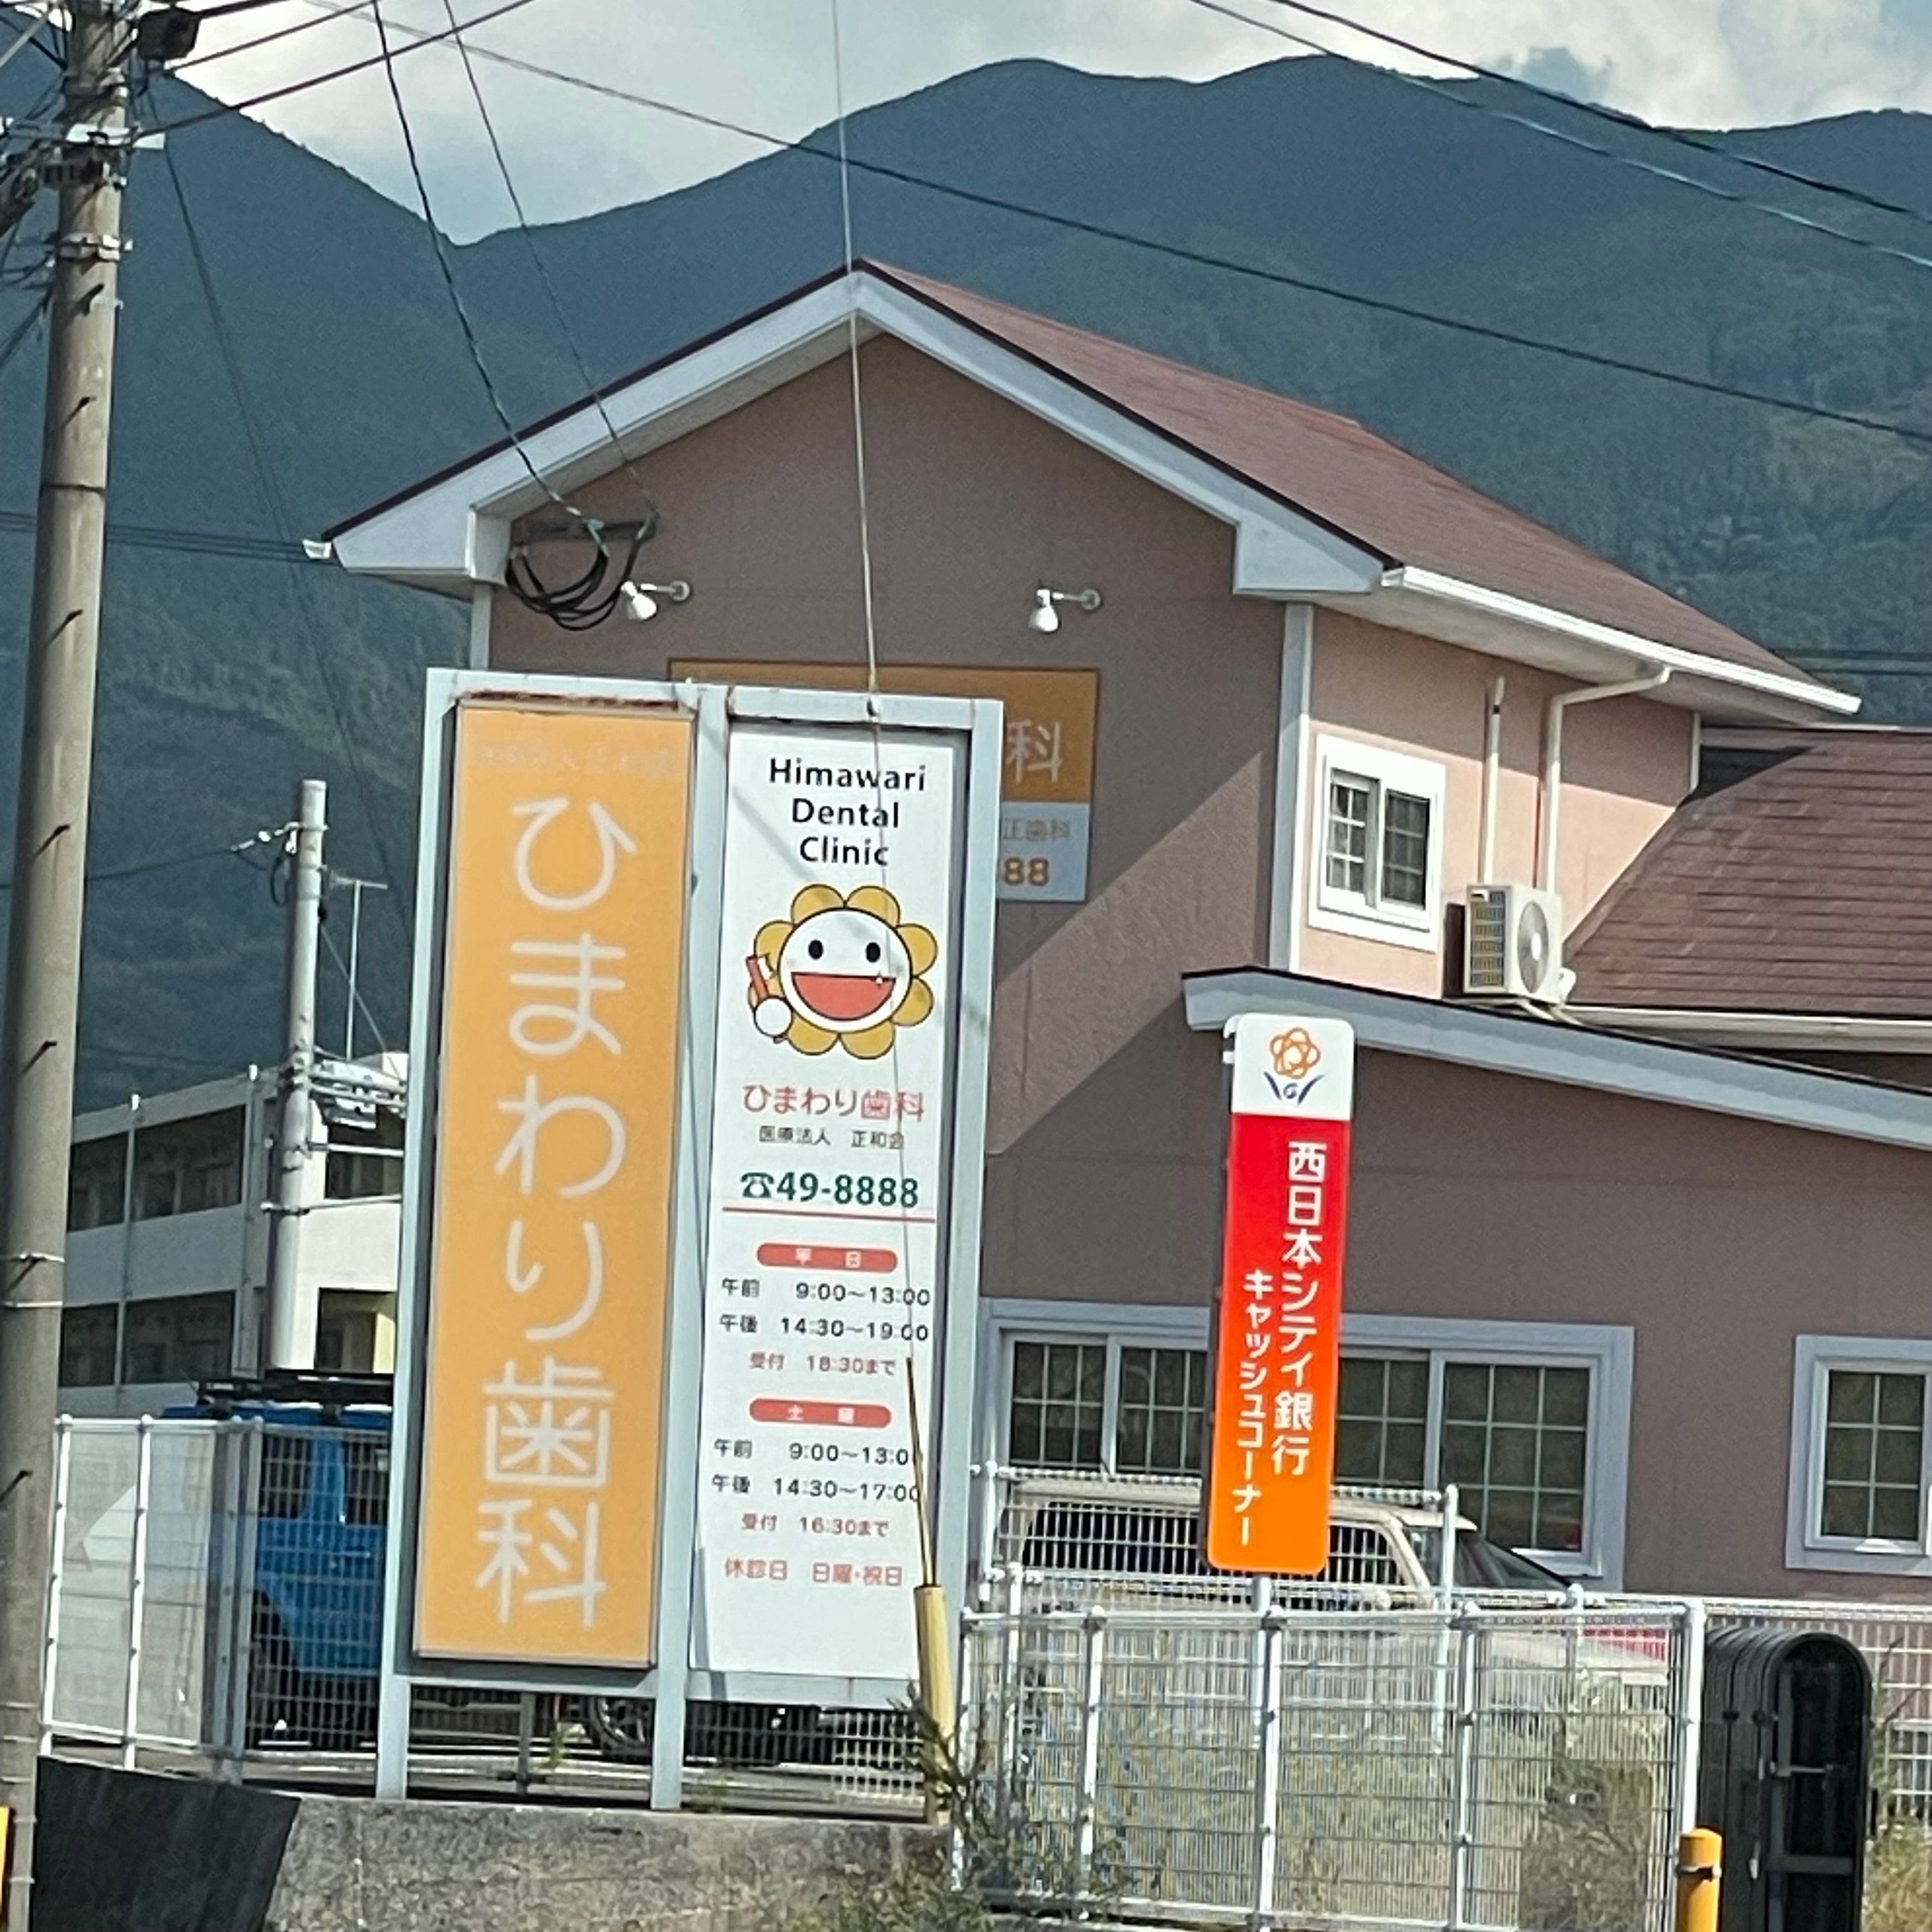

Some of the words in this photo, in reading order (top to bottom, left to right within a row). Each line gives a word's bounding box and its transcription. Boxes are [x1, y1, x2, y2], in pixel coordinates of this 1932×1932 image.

[1006, 719, 1063, 783] 科
[769, 757, 926, 791] Himawari
[792, 798, 899, 828] Dental
[800, 836, 889, 866] Clinic
[1004, 857, 1050, 887] 88
[742, 1084, 924, 1122] ひまわり歯科
[776, 1172, 919, 1208] 49-8888
[475, 796, 640, 1627] ひまわり歯科
[721, 1278, 760, 1298] 午前
[719, 1314, 758, 1333] 午後
[1272, 1140, 1328, 1476] 西日本シティ銀行
[1232, 1268, 1274, 1546] キャッシュコーナー
[714, 1438, 752, 1458] 午前
[789, 1442, 909, 1466] 9:00～13:0
[712, 1474, 750, 1494] 午後
